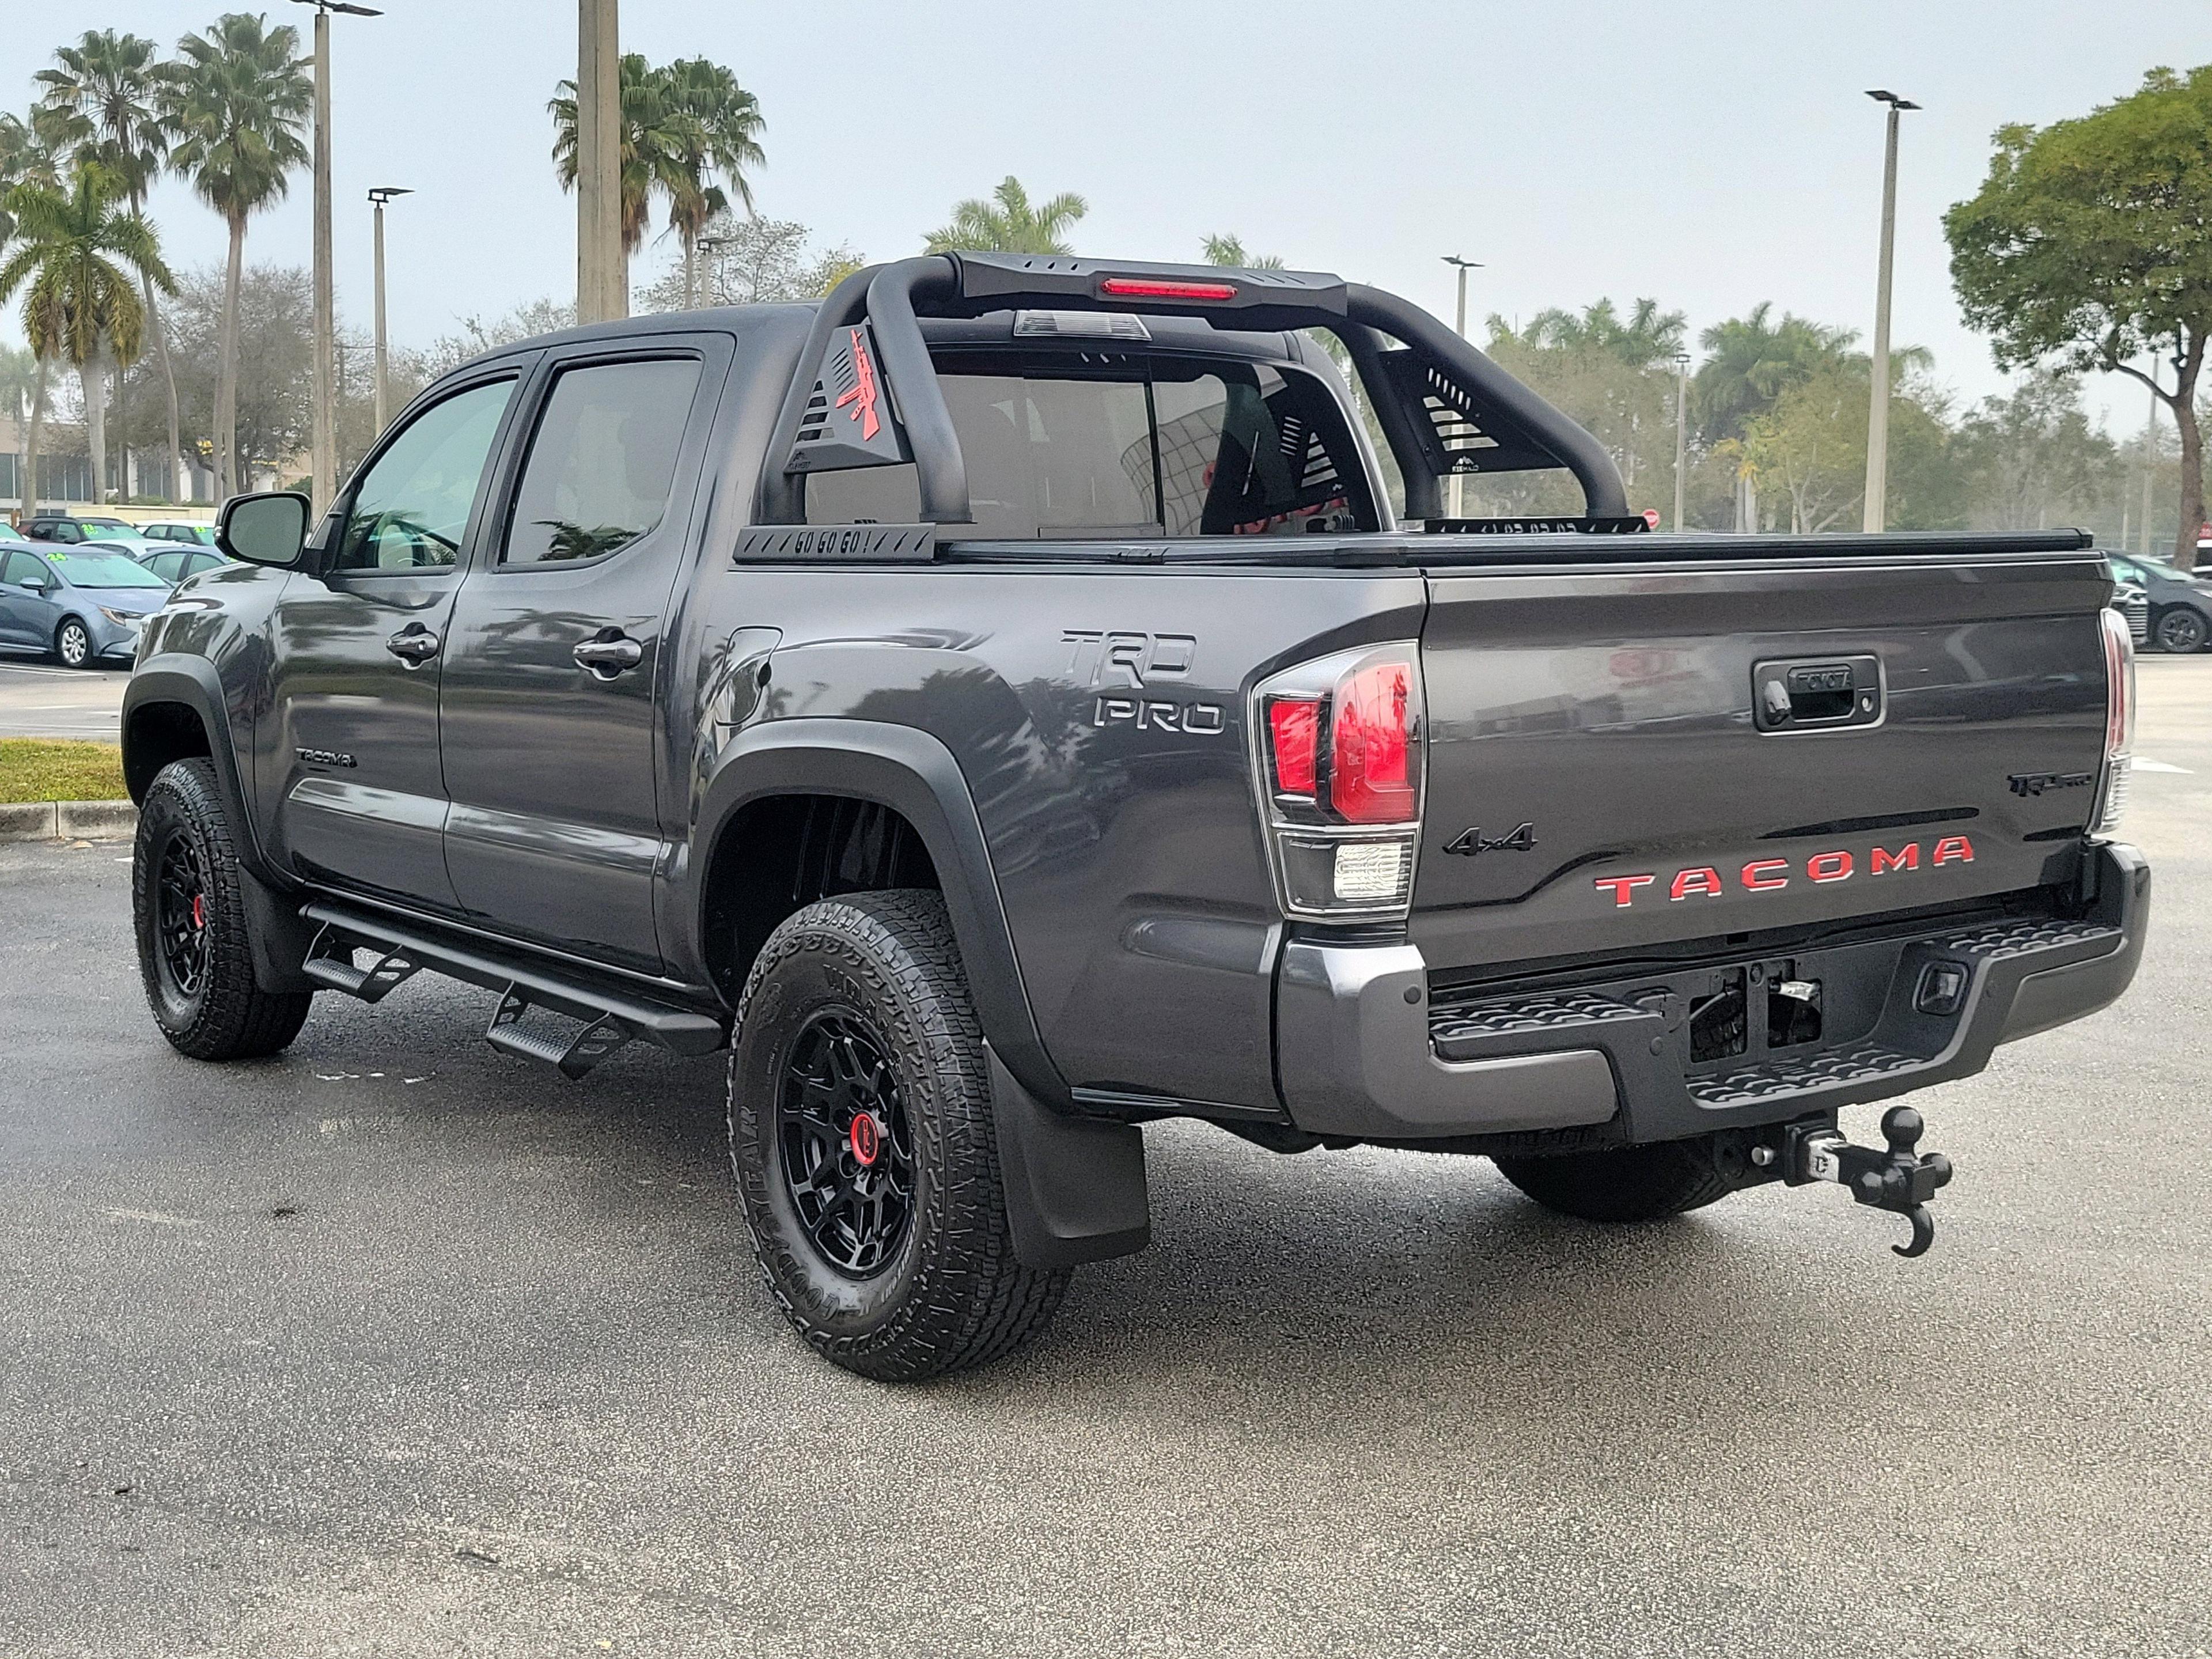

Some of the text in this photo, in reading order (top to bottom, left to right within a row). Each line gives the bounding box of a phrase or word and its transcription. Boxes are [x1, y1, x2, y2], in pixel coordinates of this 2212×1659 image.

[794, 531, 815, 554] GO
[817, 531, 838, 554] GO
[1060, 630, 1197, 689] TRD
[1797, 670, 1852, 690] TOYOTA
[1094, 696, 1227, 734] PRO
[295, 747, 357, 768] TACOMA
[1594, 835, 1974, 907] TACOMA
[740, 1105, 840, 1321] GOODYEAR
